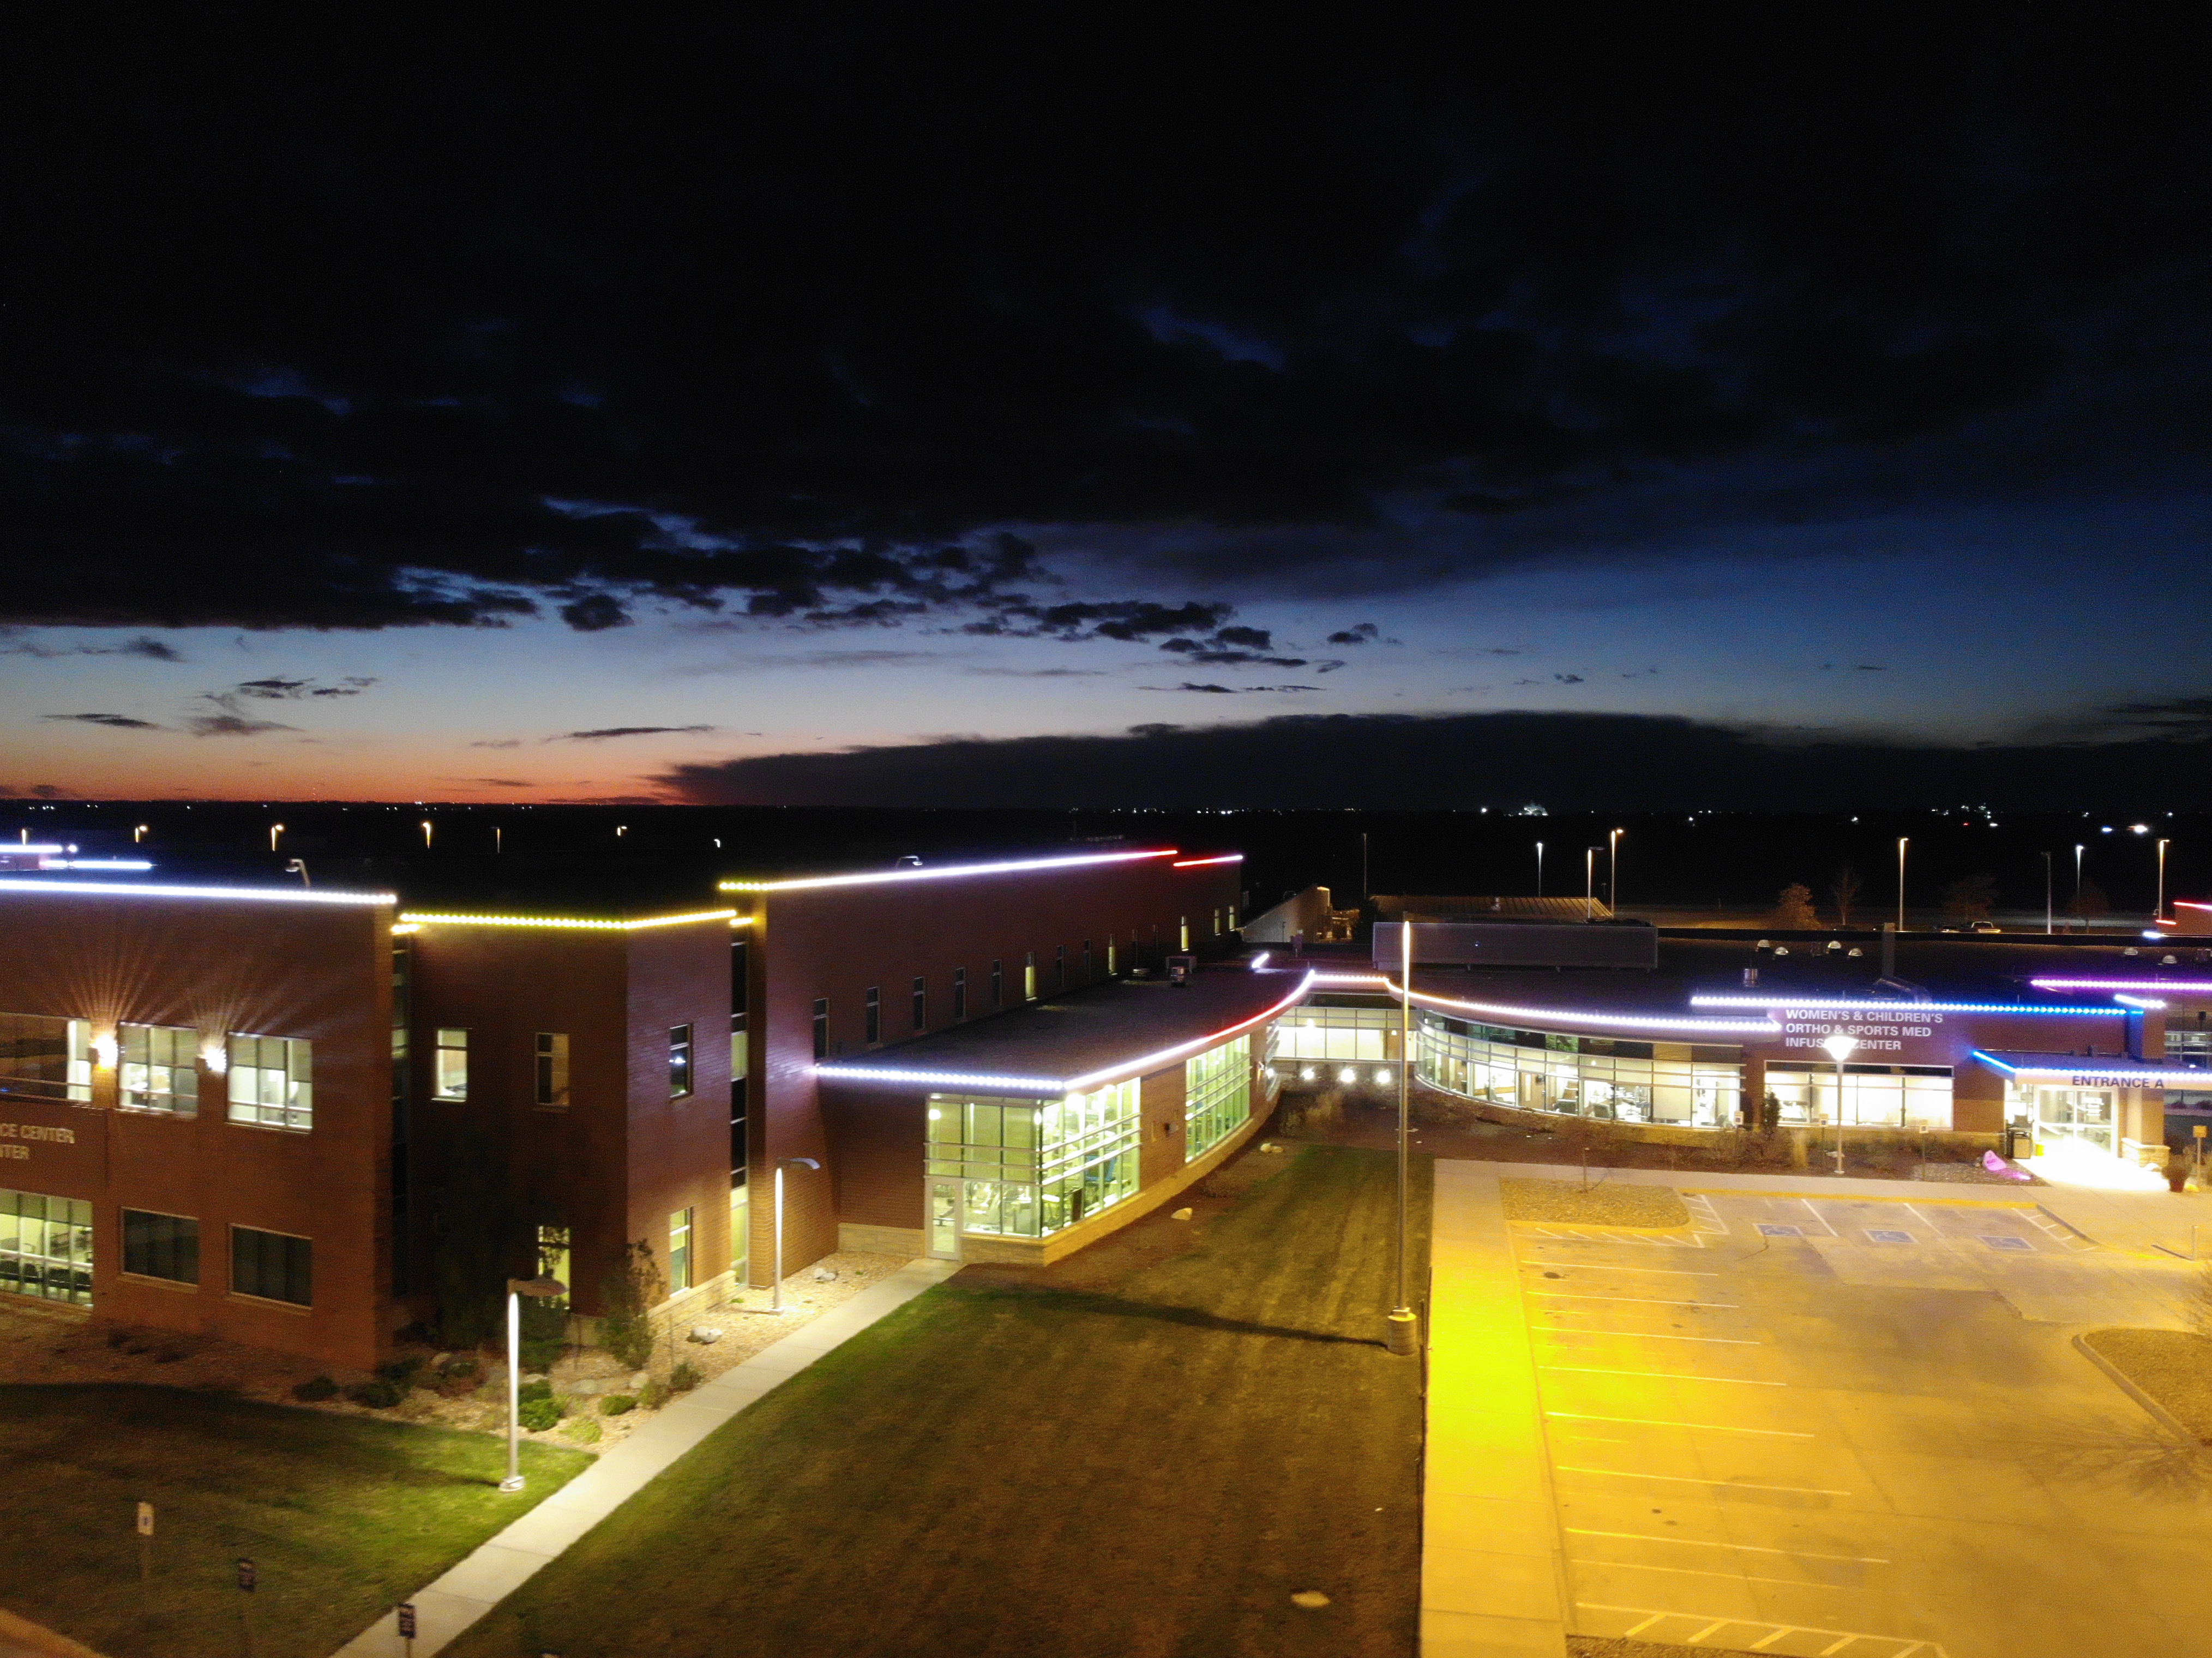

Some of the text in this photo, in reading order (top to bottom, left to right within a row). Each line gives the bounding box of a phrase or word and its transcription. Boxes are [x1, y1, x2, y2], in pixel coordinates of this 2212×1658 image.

[1786, 1009, 1943, 1023] WOMEN'S & CHILDREN'S
[1786, 1023, 1932, 1037] ORTHO & SPORTS MED
[1786, 1037, 1824, 1048] INFUS
[2072, 1075, 2165, 1089] ENTRANCE A
[20, 1125, 75, 1144] CENTER
